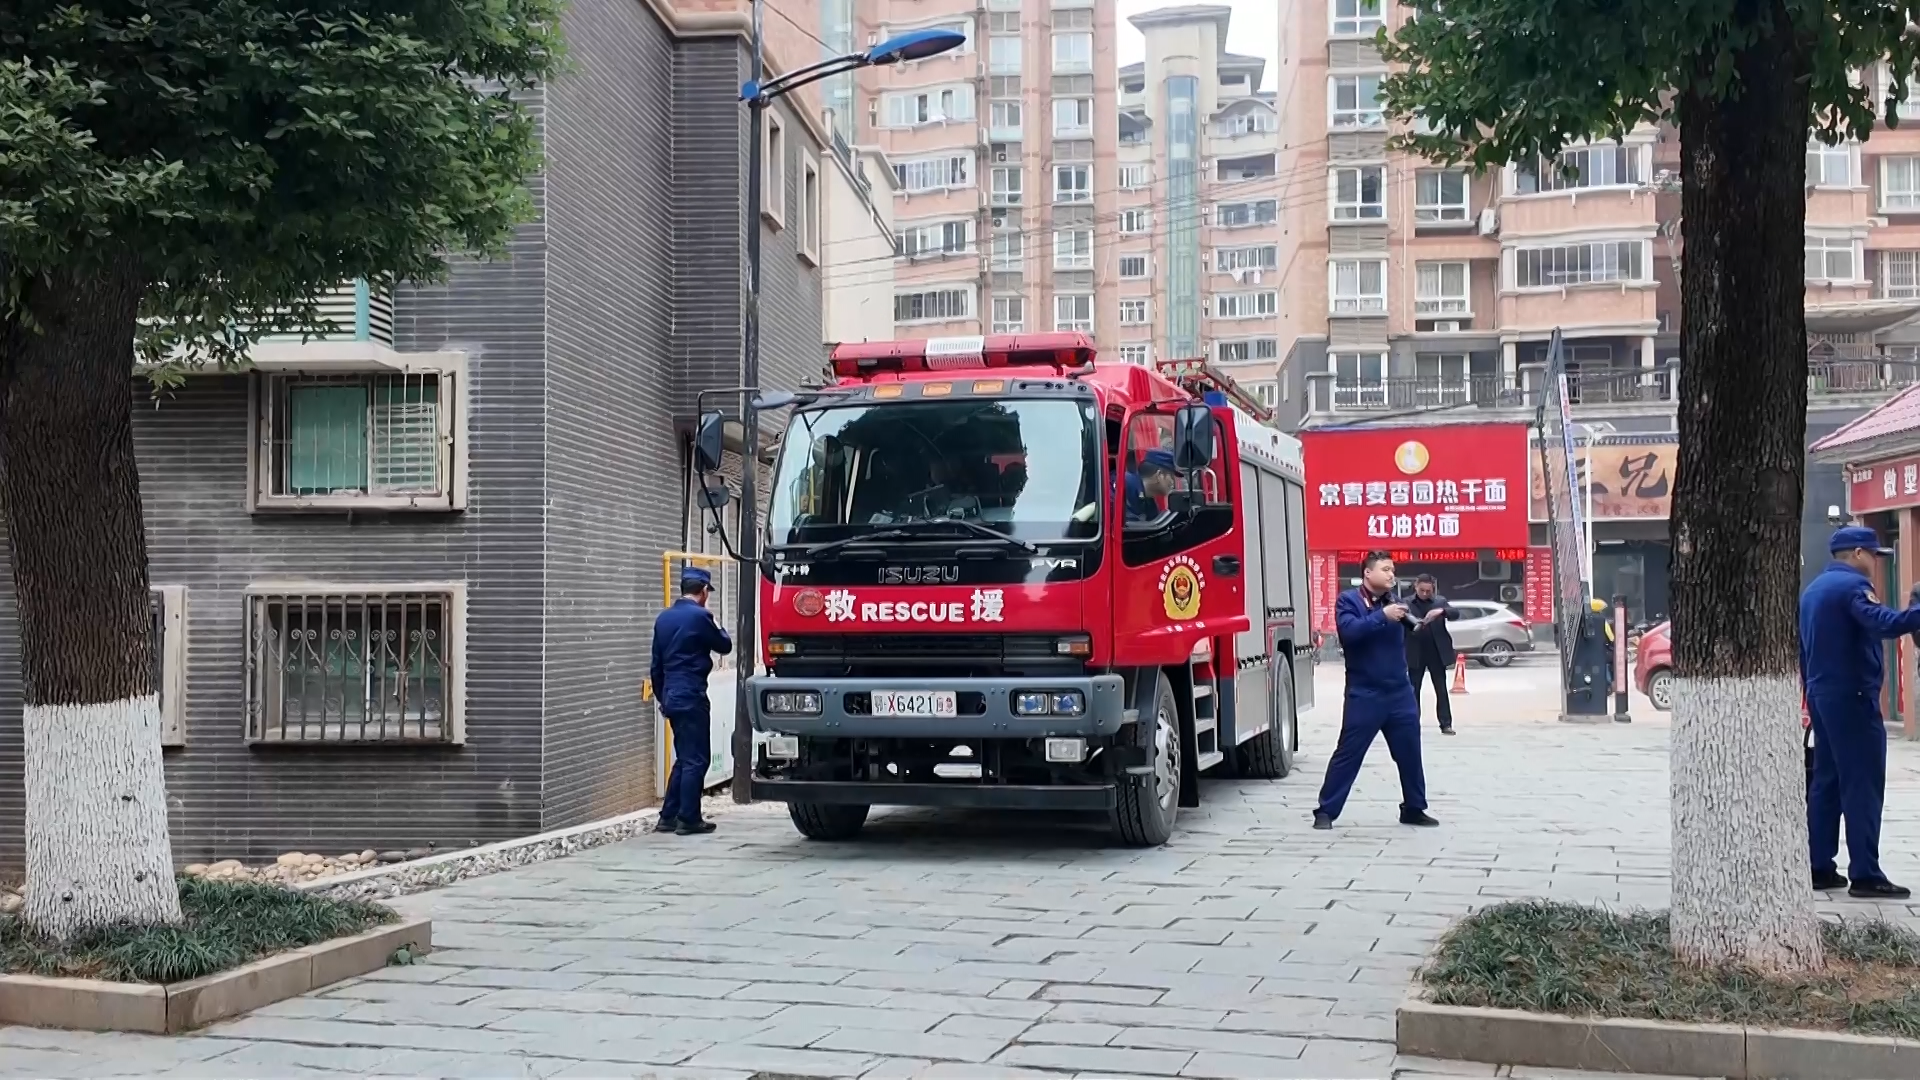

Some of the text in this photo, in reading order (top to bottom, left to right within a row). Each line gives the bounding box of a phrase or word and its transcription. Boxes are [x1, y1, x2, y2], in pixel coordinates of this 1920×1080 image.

[1319, 478, 1506, 506] 常青麦香园热干面
[1367, 513, 1460, 538] 红油拉面
[878, 565, 959, 585] ISUZU
[1031, 559, 1077, 569] FVR
[825, 588, 1004, 623] 救 RESCUE 援
